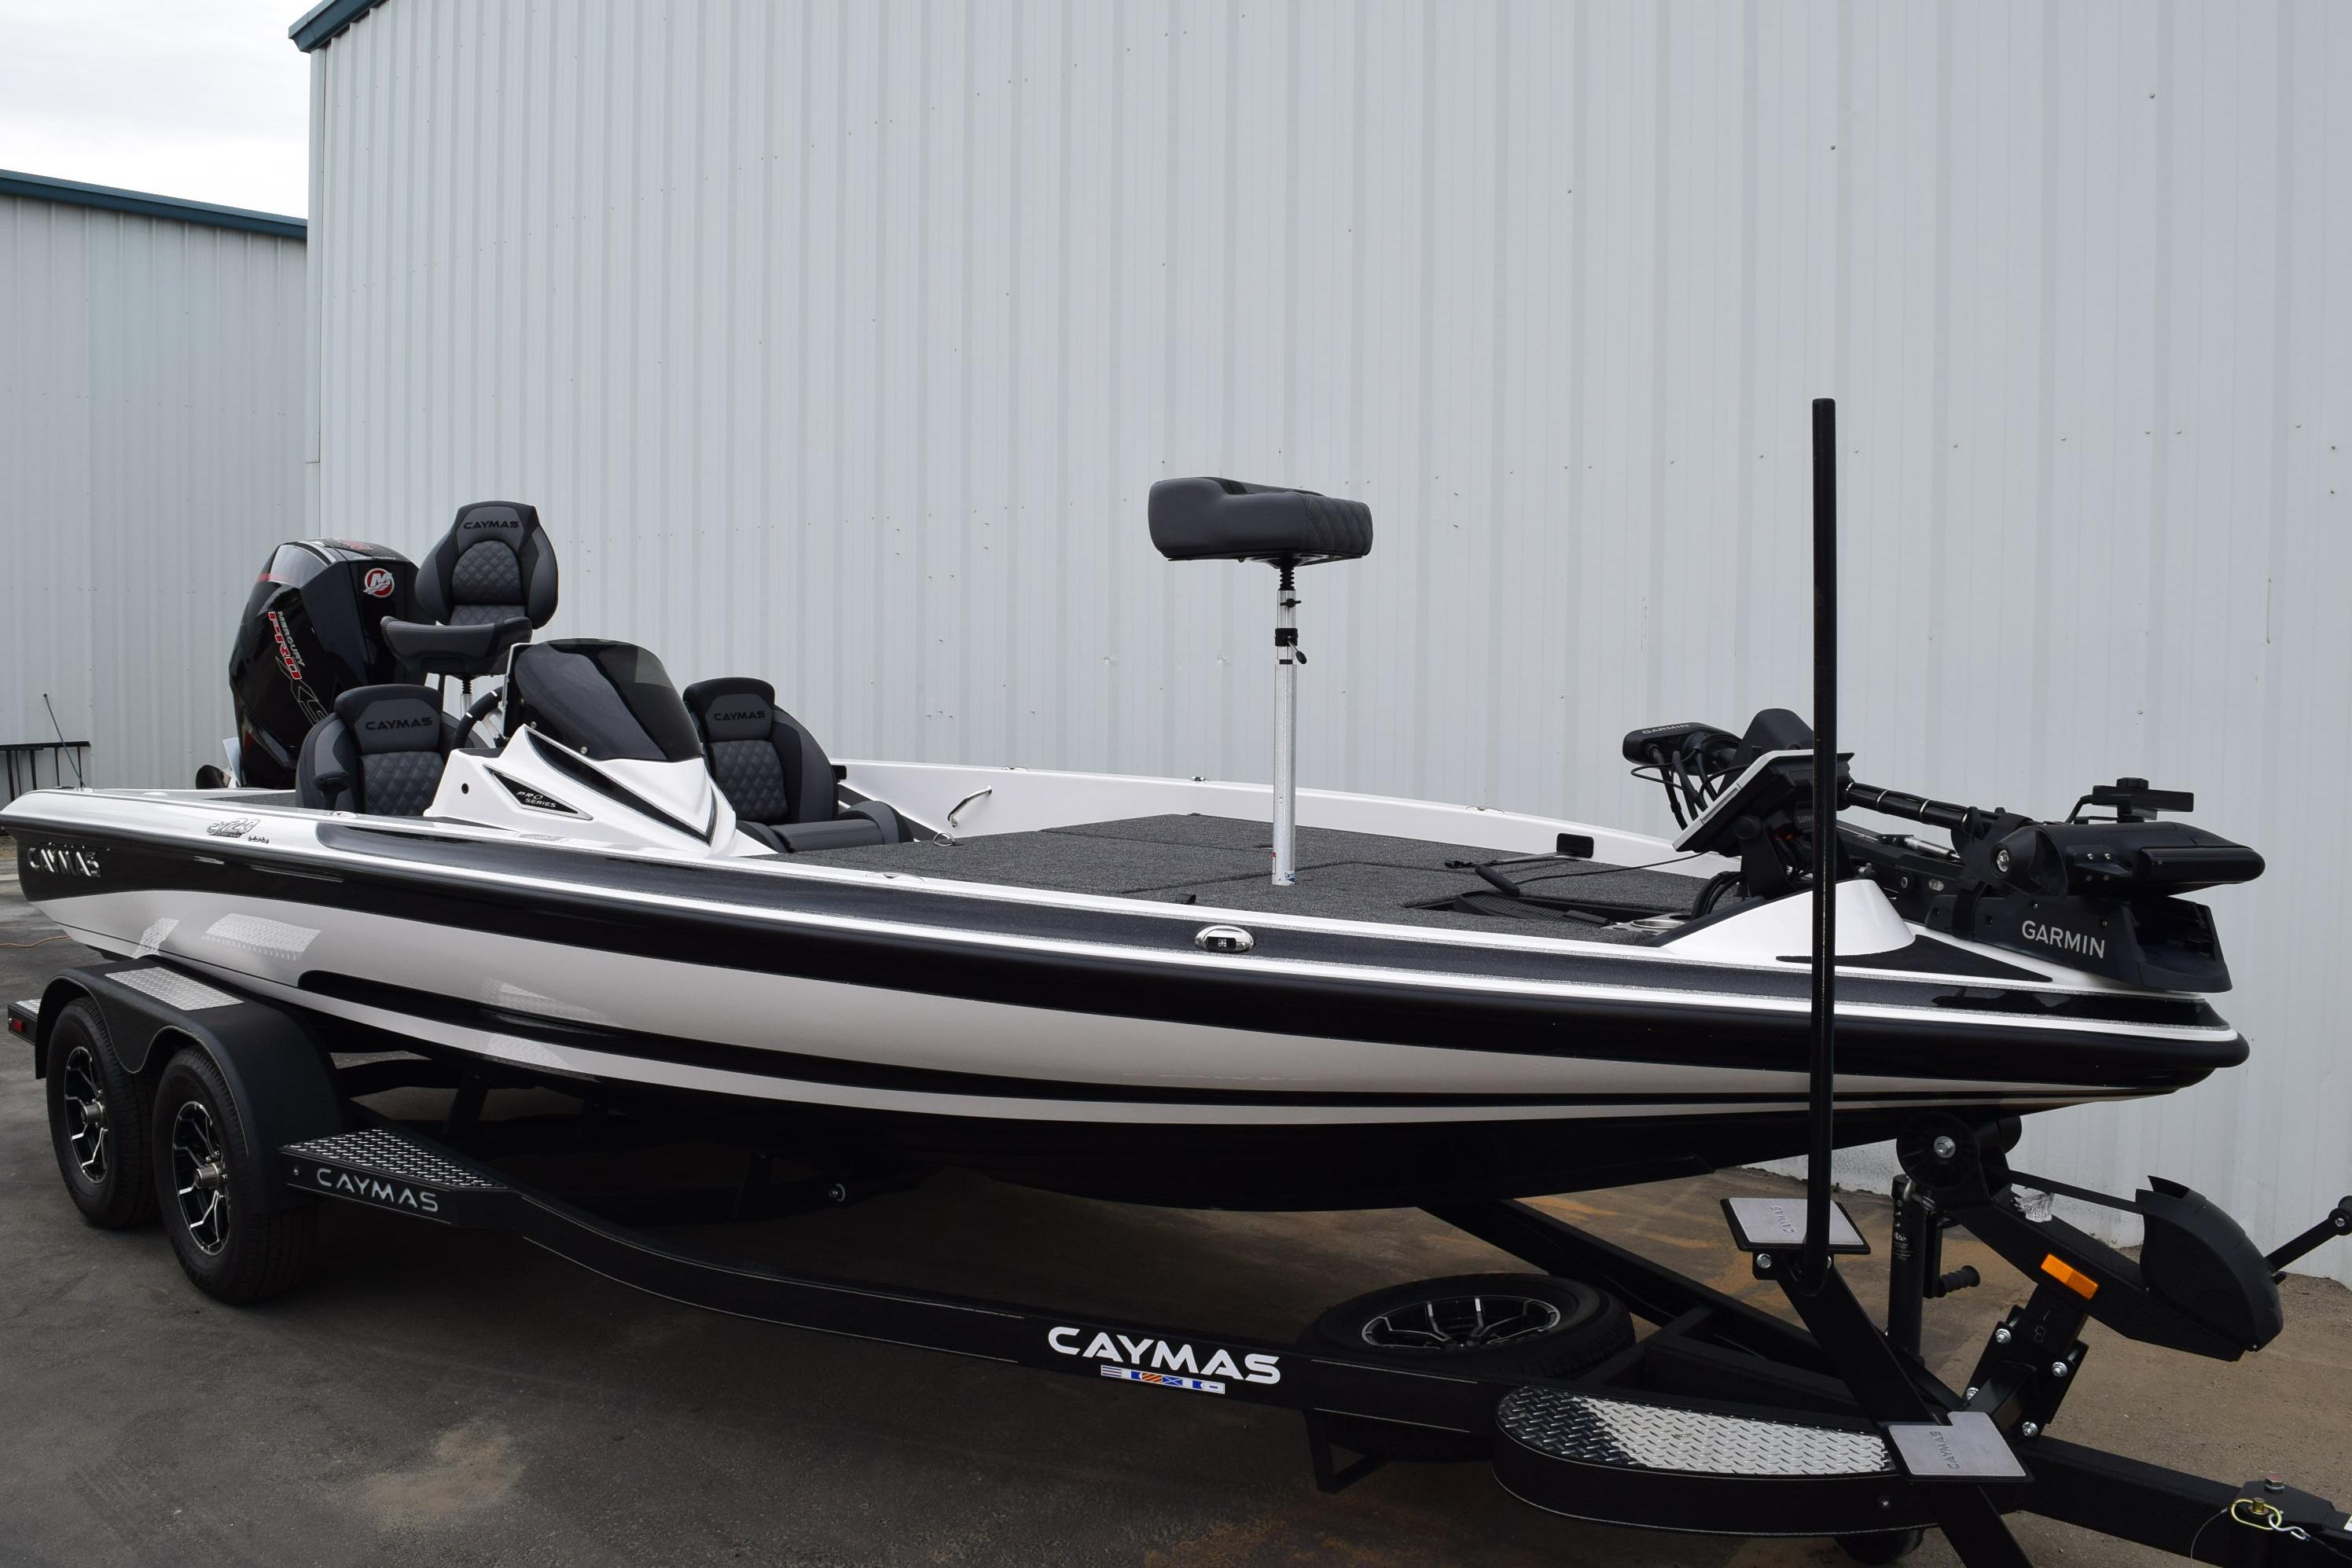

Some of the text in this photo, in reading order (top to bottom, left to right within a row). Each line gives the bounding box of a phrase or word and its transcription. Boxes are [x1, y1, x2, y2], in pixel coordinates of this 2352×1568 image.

[463, 520, 519, 530] CAYMAS
[268, 611, 302, 680] PRO
[277, 610, 306, 667] MERCURY
[365, 717, 432, 730] CAYMAS
[711, 711, 766, 722] CAYMAS
[1641, 724, 1690, 734] GARMIN
[516, 791, 543, 800] PRO
[524, 798, 557, 808] SERIES
[2022, 920, 2105, 959] GARMIN
[317, 1168, 439, 1212] CAYMAS
[1048, 1326, 1281, 1385] CAYMAS
[1929, 1430, 1960, 1470] CAYMAS
